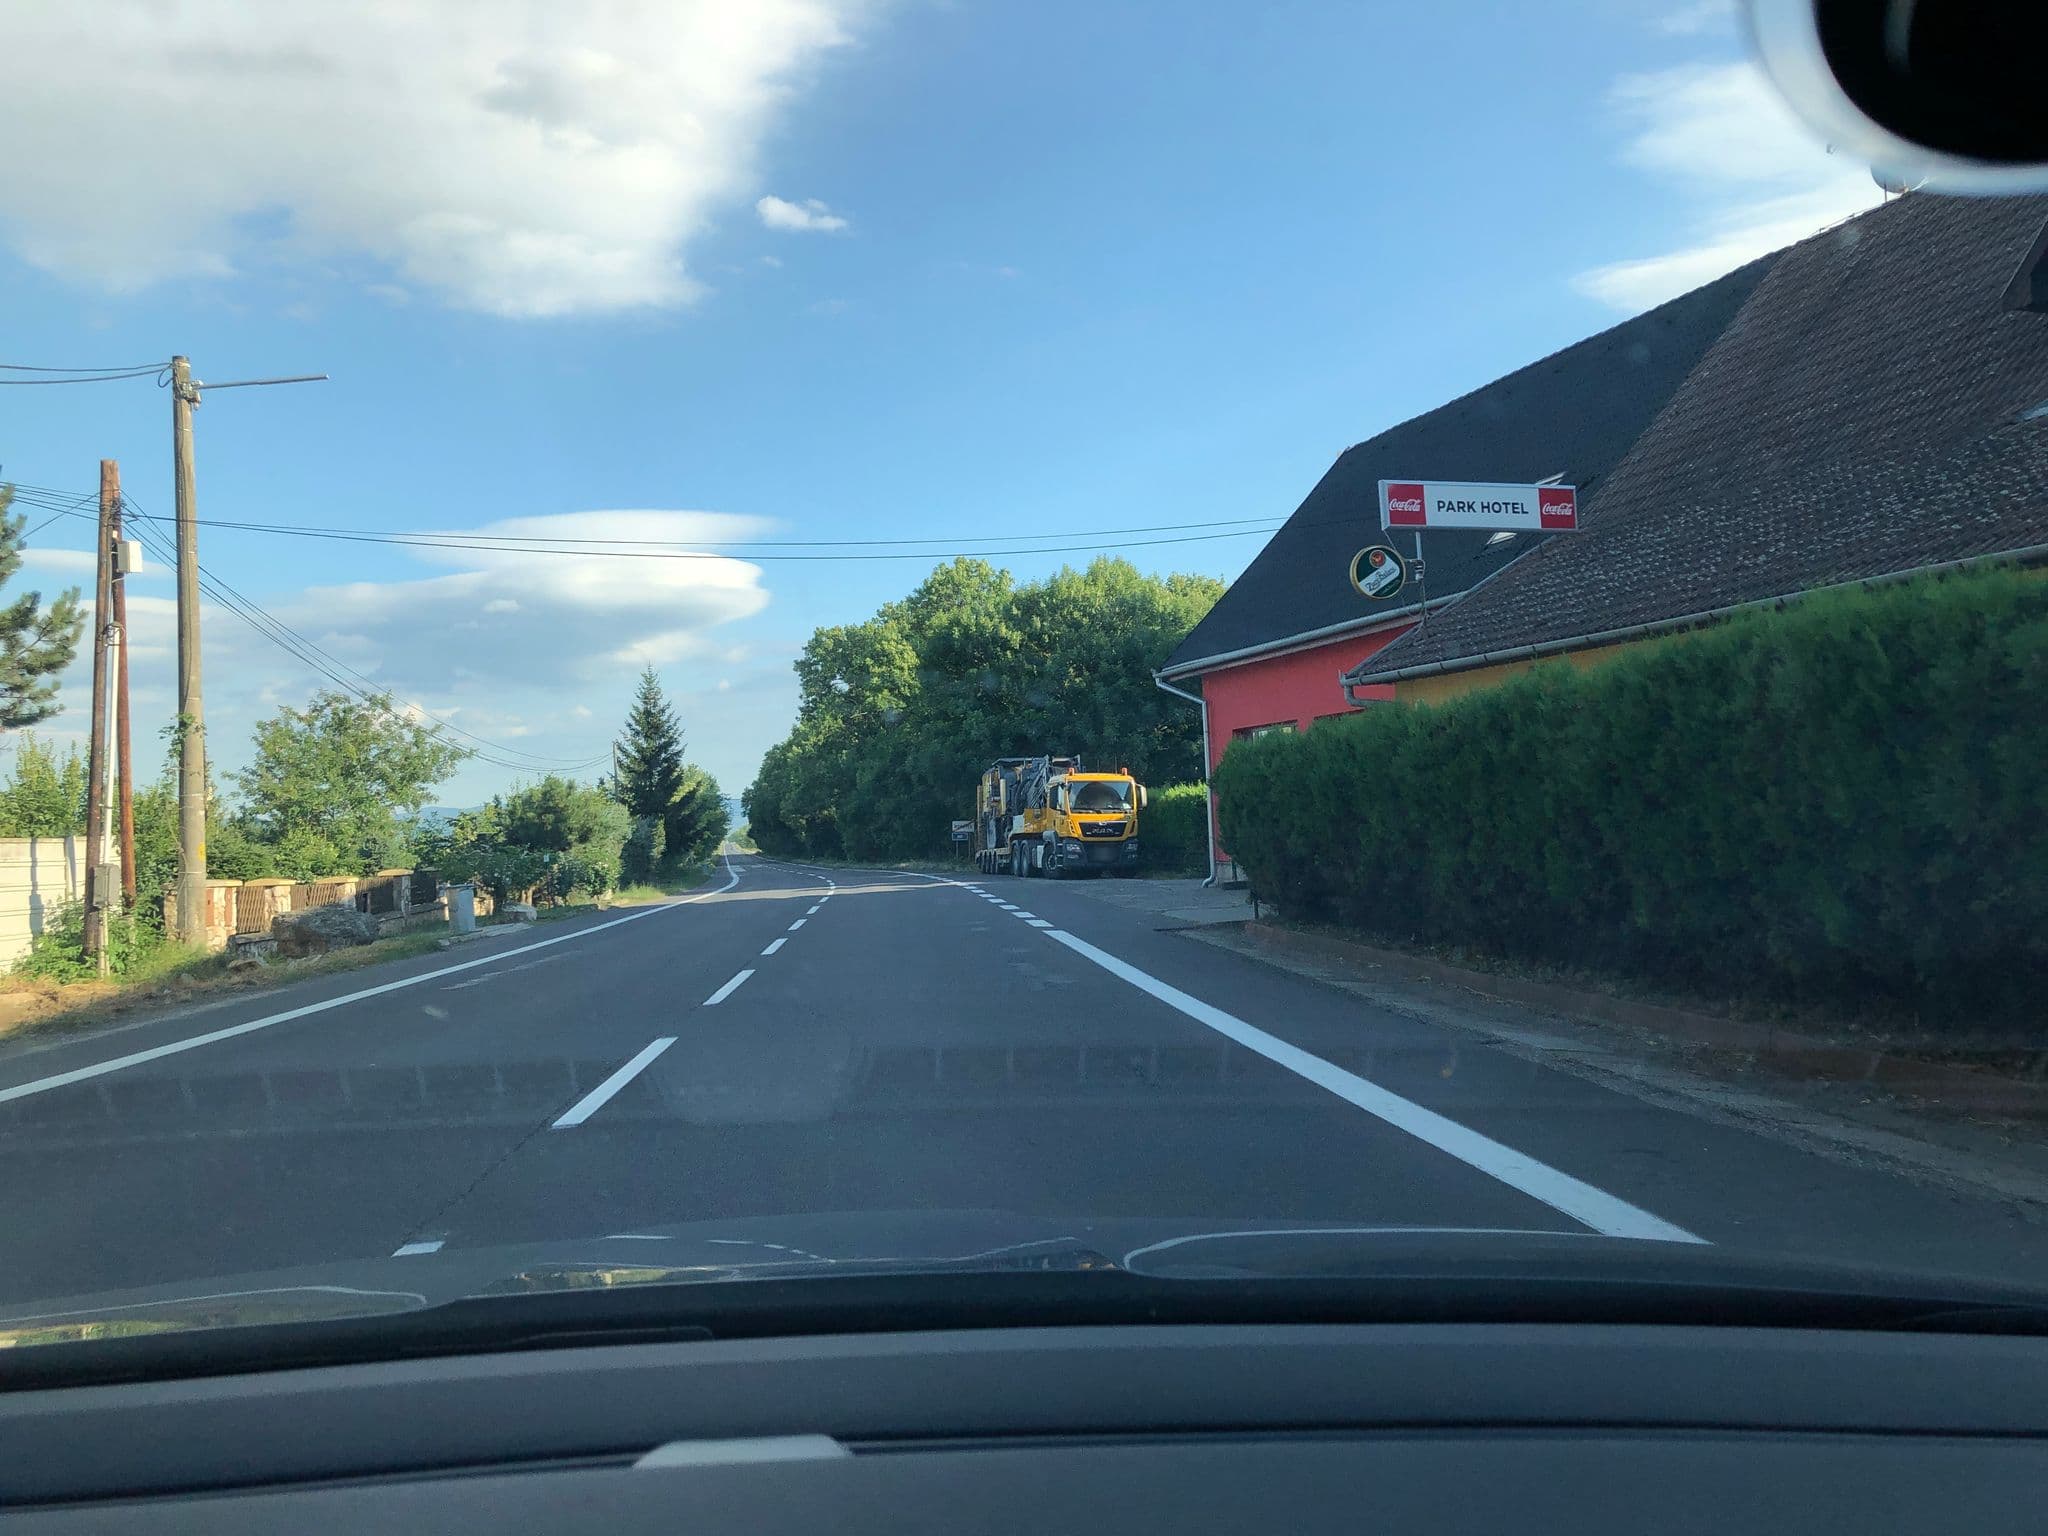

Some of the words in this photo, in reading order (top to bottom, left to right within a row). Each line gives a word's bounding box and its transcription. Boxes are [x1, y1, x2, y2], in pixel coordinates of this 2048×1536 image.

[1389, 498, 1422, 511] Coca-Cola
[1437, 500, 1476, 513] PARK
[1481, 501, 1529, 514] HOTEL
[1542, 502, 1573, 515] Coca-Cola
